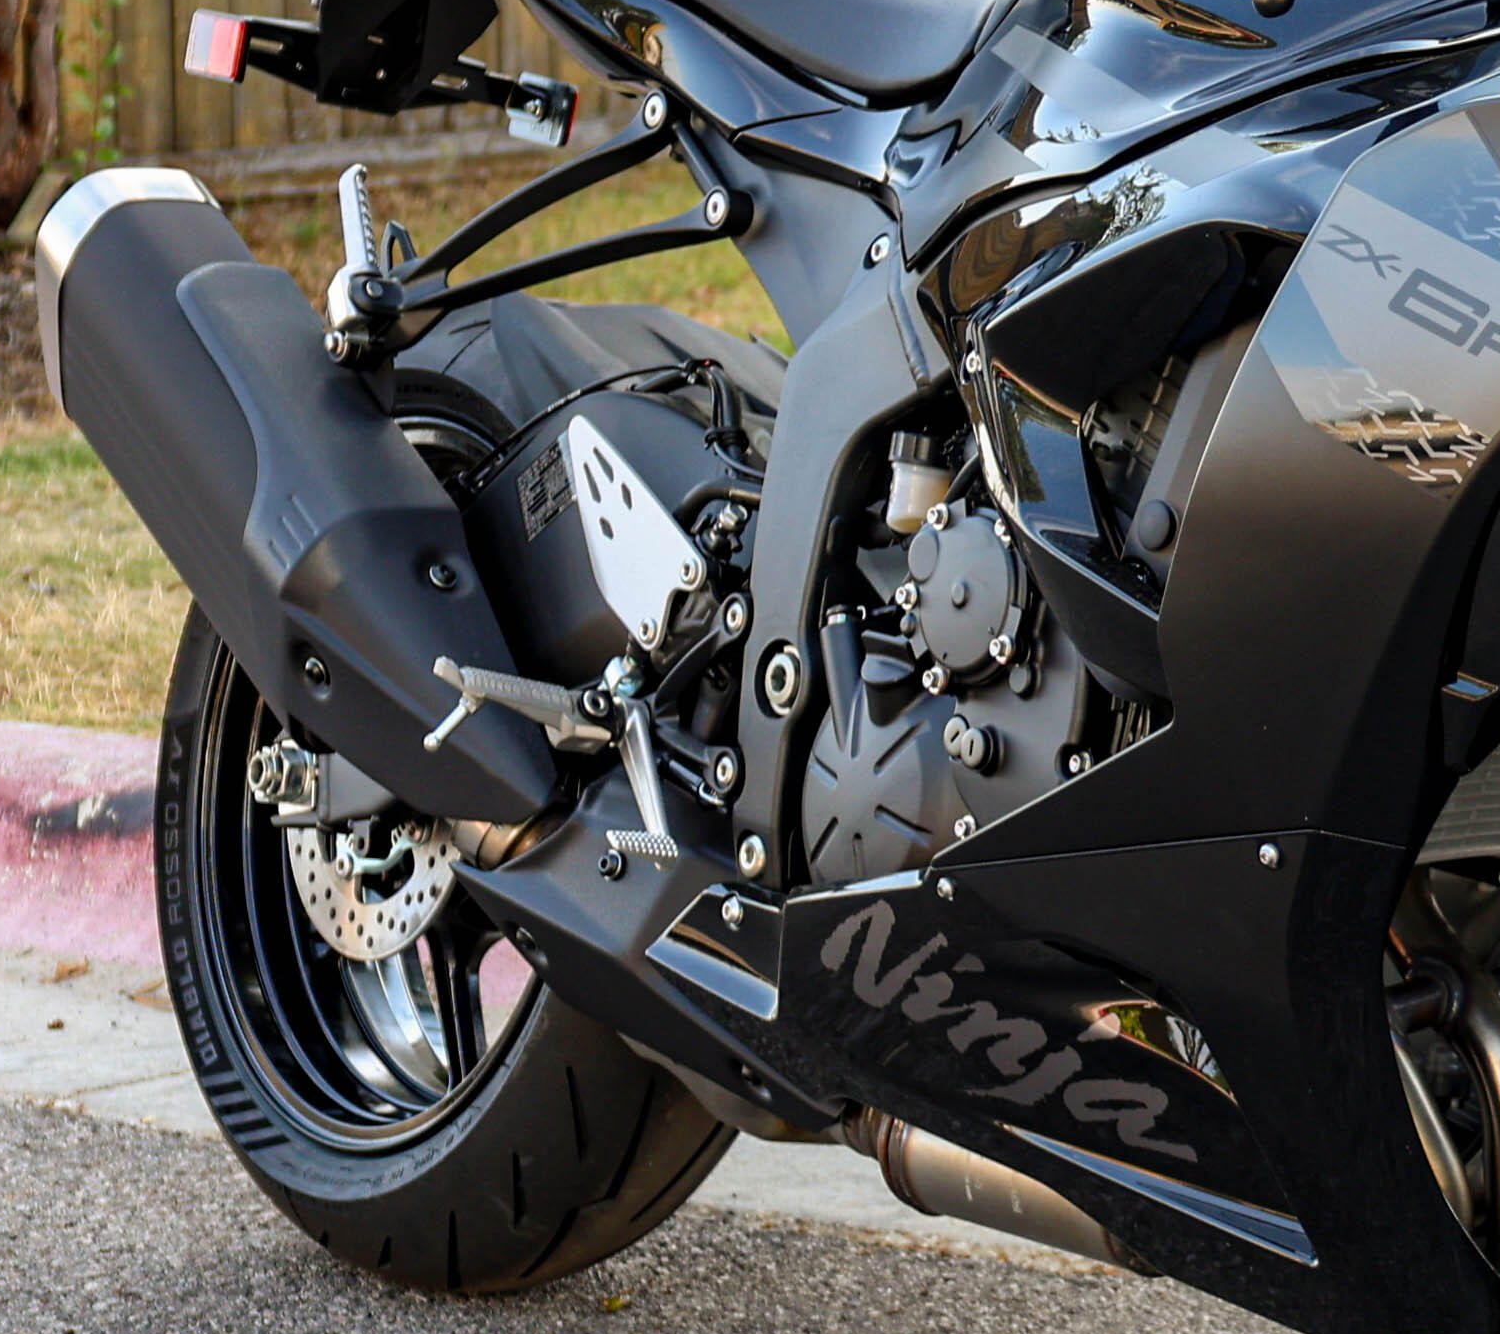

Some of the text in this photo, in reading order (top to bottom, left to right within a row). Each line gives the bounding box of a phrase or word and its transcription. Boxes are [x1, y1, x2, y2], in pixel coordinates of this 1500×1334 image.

[163, 802, 186, 926] ROSSO
[171, 936, 220, 1067] DIABLO
[819, 899, 1199, 1164] Ninja
